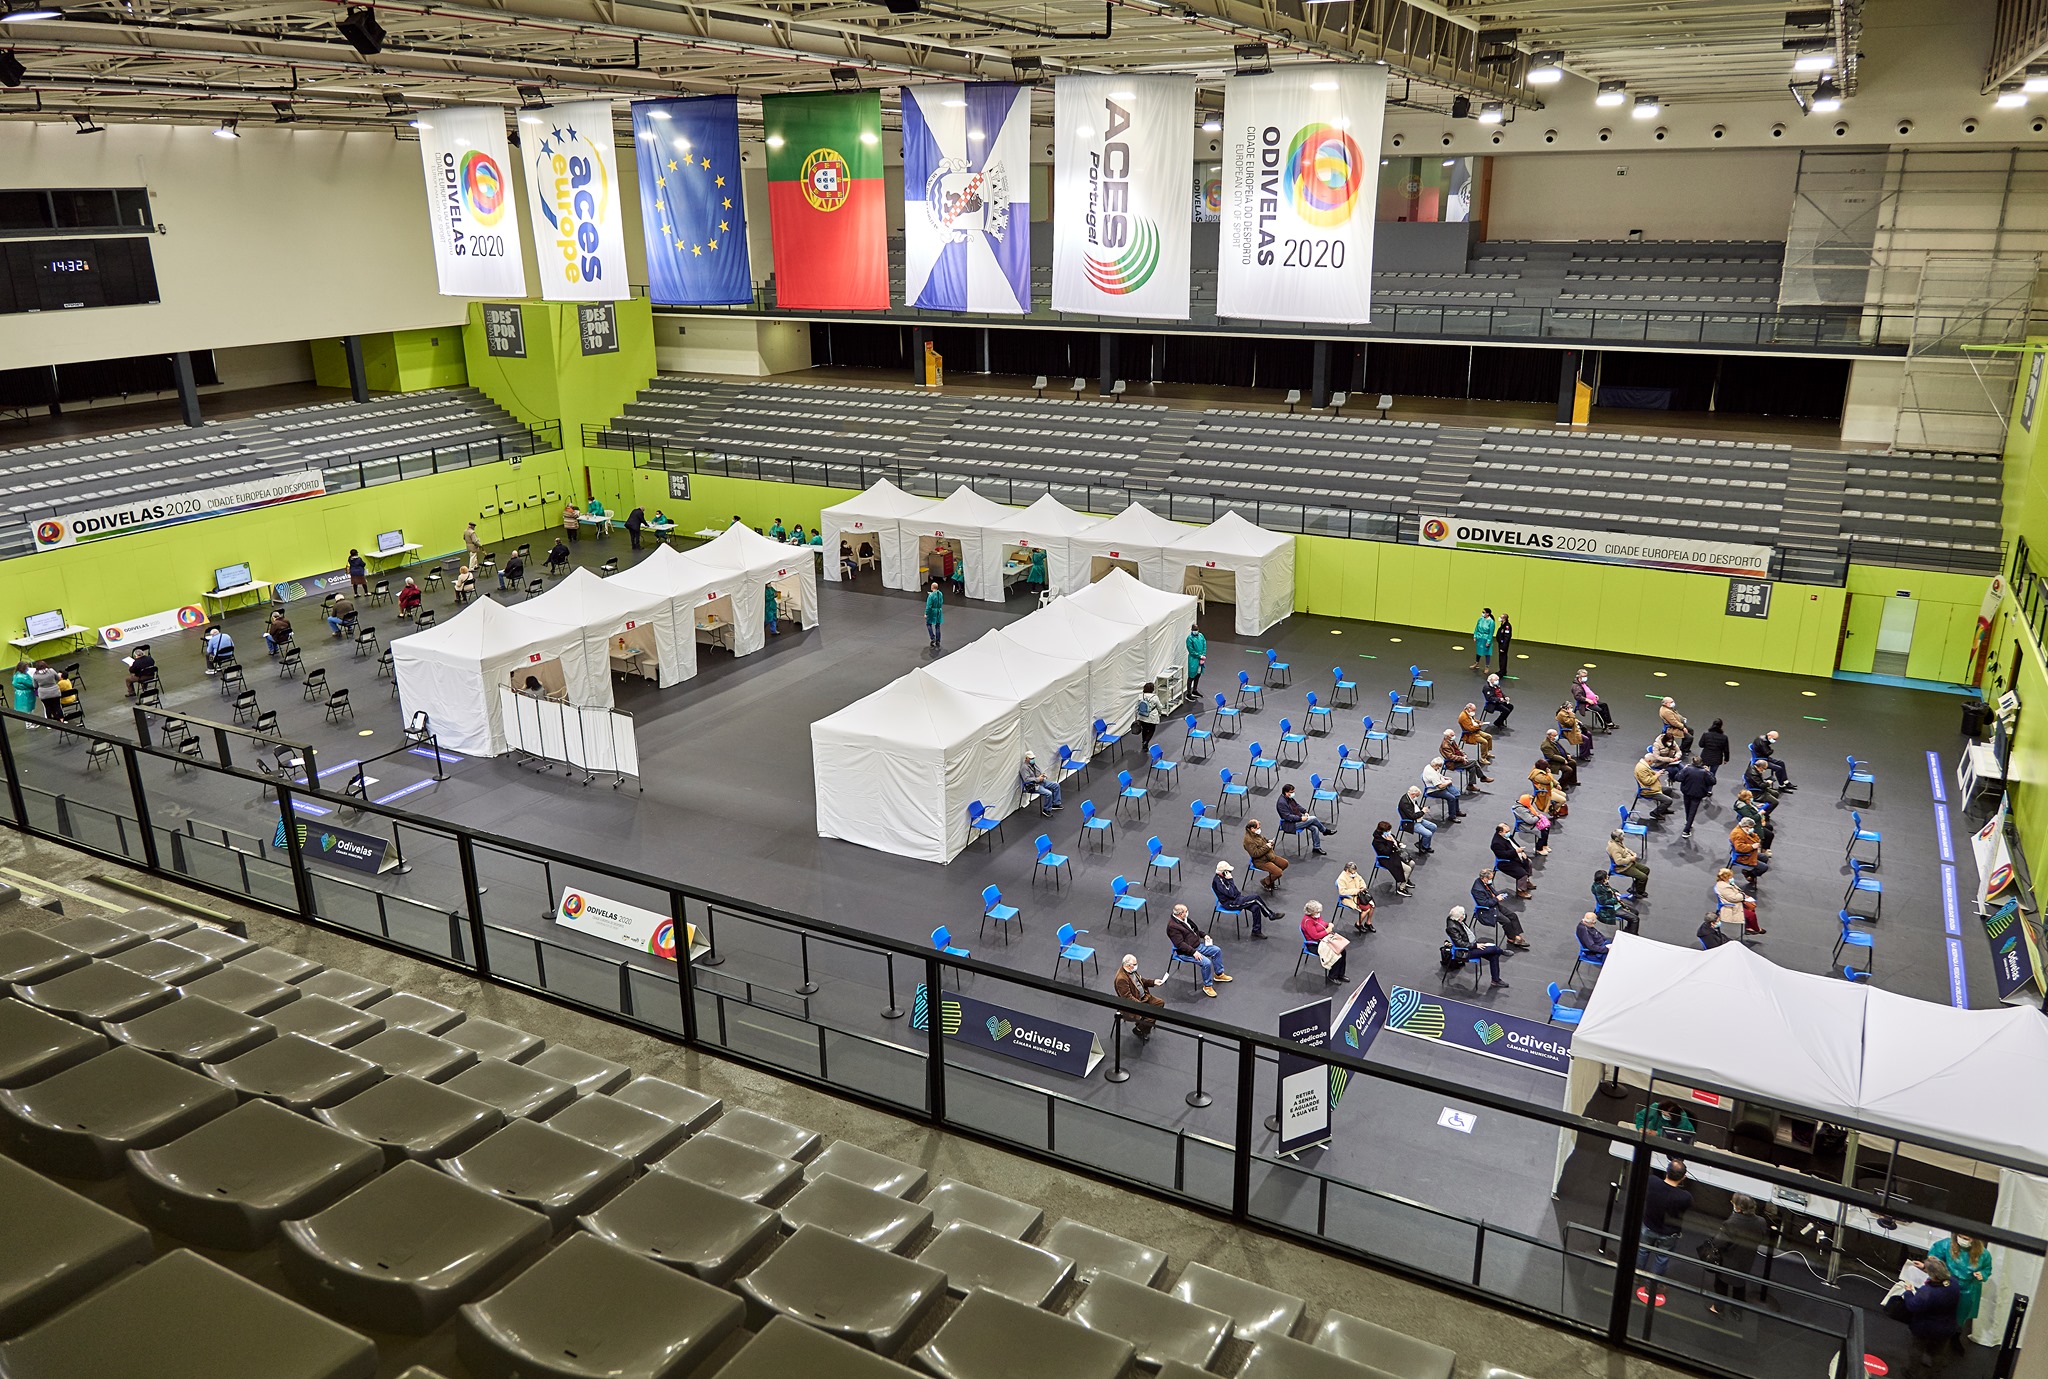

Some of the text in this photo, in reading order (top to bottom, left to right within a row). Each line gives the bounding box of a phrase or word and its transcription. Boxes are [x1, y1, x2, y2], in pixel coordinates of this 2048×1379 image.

[1102, 97, 1131, 248] ACES
[443, 152, 466, 256] ODIVELAS
[1086, 150, 1100, 246] Portugal
[1193, 178, 1203, 223] ODIVELAS
[1232, 143, 1245, 248] EUROPEAN CITY OF SPORT
[1241, 126, 1256, 265] CIDADE EUROPEIA DO DESPORTO
[1257, 126, 1281, 266] ODIVELAS
[552, 153, 581, 284] europe
[569, 155, 602, 283] aces
[470, 235, 504, 257] 2020
[1283, 238, 1345, 269] 2020
[52, 260, 83, 272] 14:32
[491, 310, 512, 325] DES
[586, 307, 606, 322] DES
[493, 324, 516, 339] POR
[587, 321, 610, 336] POR
[494, 338, 509, 351] TO
[588, 335, 603, 349] TO
[72, 504, 165, 535] ODIVELAS
[166, 499, 201, 517] 2020
[207, 495, 235, 509] CIDADE
[235, 489, 271, 504] EUROPEIA
[272, 486, 284, 496] DO
[284, 479, 320, 495] DESPORTO
[1456, 525, 1762, 568] ODIVELAS 2020 CIDADE EUROPEIA DO DESPORTO
[1737, 583, 1761, 595] DES
[1735, 603, 1750, 613] TO
[1736, 593, 1761, 605] POR
[337, 839, 373, 858] Odivelas
[586, 905, 618, 921] ODIVELAS
[618, 915, 633, 926] 2020
[1355, 995, 1378, 1030] Odivelas
[1014, 1027, 1071, 1053] Odivelas
[1292, 1025, 1319, 1038] COVID-19
[1032, 1045, 1058, 1056] MUNICIPAL
[1506, 1043, 1560, 1062] CÂMARA MUNICIPAL
[1507, 1032, 1572, 1058] Odivelas
[1295, 1089, 1315, 1100] RETIRE
[1298, 1095, 1317, 1105] SENHA
[1294, 1099, 1320, 1112] AGUARDE
[1296, 1109, 1308, 1117] SUA
[1308, 1105, 1318, 1113] VEZ
